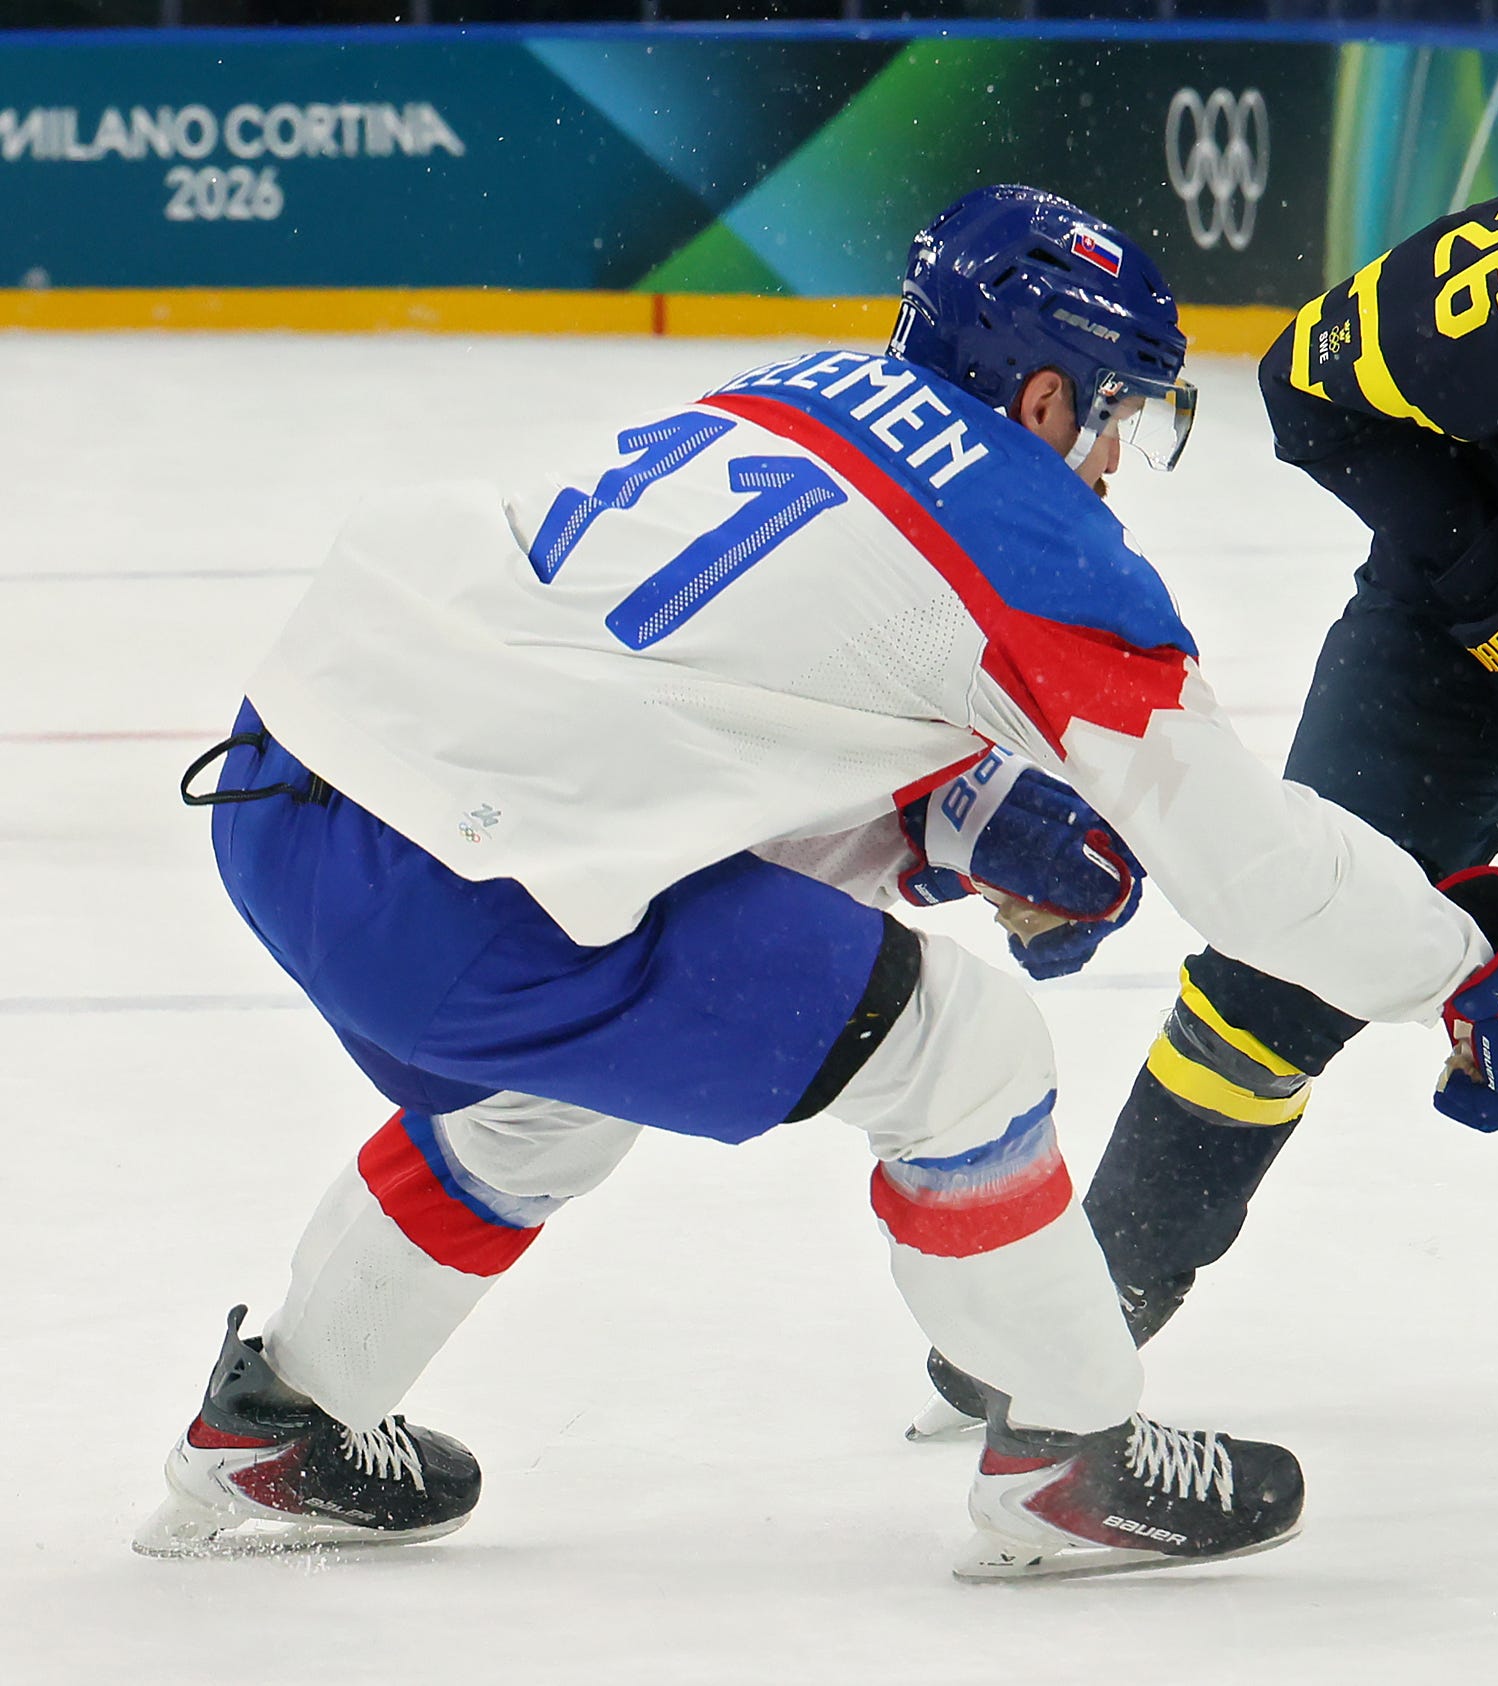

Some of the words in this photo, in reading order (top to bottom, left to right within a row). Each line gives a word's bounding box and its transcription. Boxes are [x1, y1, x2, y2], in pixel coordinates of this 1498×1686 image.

[0, 105, 218, 160] MILANO
[224, 103, 465, 158] CORTINA
[164, 165, 284, 221] 2026
[1319, 330, 1329, 364] SWE
[704, 351, 990, 490] ELEMEN
[529, 411, 848, 651] 11
[1482, 1035, 1496, 1091] BAUER
[1102, 1513, 1189, 1547] BAUER
